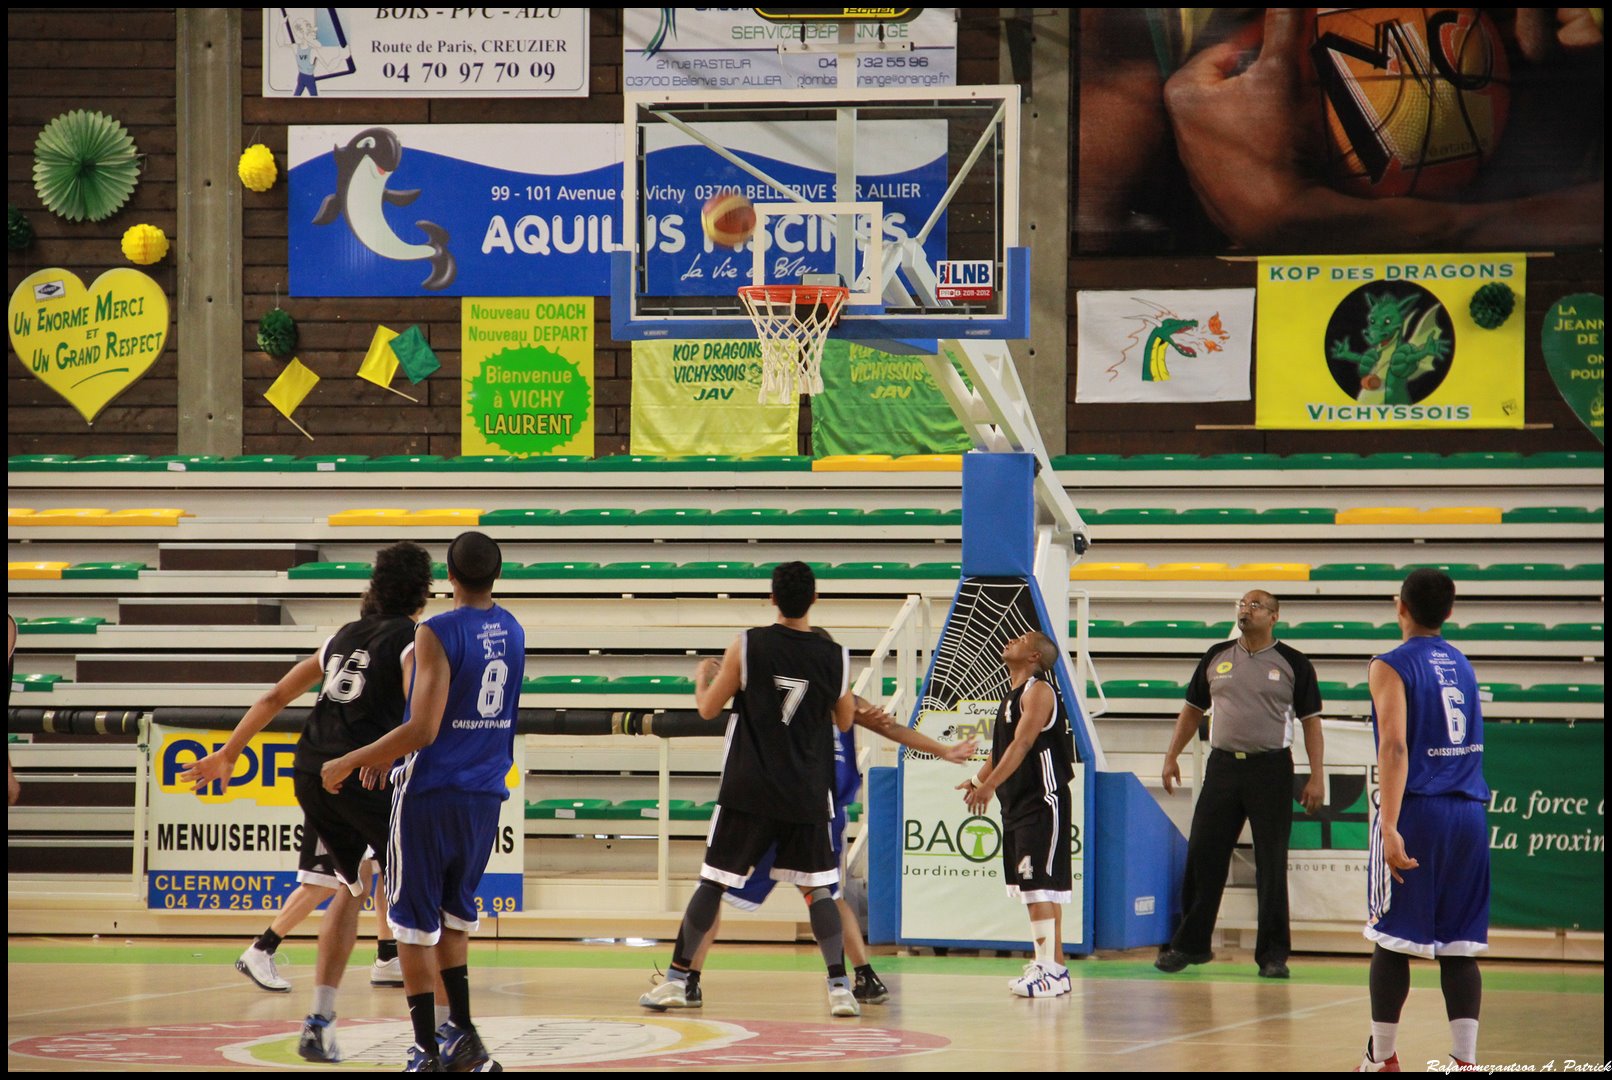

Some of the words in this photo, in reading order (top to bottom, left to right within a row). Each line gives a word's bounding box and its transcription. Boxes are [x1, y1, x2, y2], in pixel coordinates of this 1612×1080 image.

[375, 8, 429, 19] BOIS
[450, 8, 495, 19] PVC
[515, 8, 562, 19] ALU
[731, 24, 801, 40] SERVICE
[371, 40, 412, 53] Route
[416, 40, 432, 53] de
[437, 40, 477, 55] Paris,
[481, 39, 567, 53] CREUZIER
[656, 59, 669, 70] 21
[671, 60, 691, 70] rue
[693, 59, 751, 70] PASTEUR
[818, 57, 837, 69] 04
[864, 57, 883, 68] 32
[886, 57, 905, 68] 55
[909, 57, 929, 68] 96
[382, 62, 410, 83] 04
[421, 62, 447, 83] 70
[459, 62, 484, 83] 97
[494, 62, 520, 83] 70
[529, 62, 555, 83] 09
[625, 76, 670, 87] 03700
[719, 77, 740, 87] sur
[742, 75, 782, 86] ALLIER
[491, 185, 510, 200] 99
[526, 185, 551, 200] 101
[556, 185, 616, 201] Avenue
[646, 185, 686, 204] Vichy
[832, 183, 863, 199] SR
[868, 183, 921, 199] ALLIER
[703, 212, 908, 254] SCINES
[681, 253, 704, 281] La
[951, 263, 990, 284] LNB
[1269, 266, 1321, 282] KOP
[1331, 267, 1375, 281] DES
[1385, 263, 1515, 281] DRAGONS
[471, 304, 530, 320] Nouveau
[535, 303, 586, 320] COACH
[1557, 304, 1577, 316] LA
[86, 328, 100, 340] ET
[468, 326, 528, 342] Nouveau
[533, 325, 588, 342] DEPART
[1577, 333, 1600, 345] DE
[672, 342, 700, 361] KOP
[703, 341, 763, 361] DRAGONS
[485, 365, 573, 384] Bienvenue
[673, 363, 747, 384] VICHYSSOIS
[850, 361, 924, 384] VICHYSSOIS
[493, 390, 503, 409] à
[510, 390, 565, 409] VICHY
[693, 387, 735, 401] JAV
[870, 385, 912, 399] JAV
[1306, 403, 1472, 421] VICHYSSOIS
[484, 413, 574, 435] LAURENT
[318, 648, 371, 704] 16
[476, 659, 509, 718] 8
[772, 674, 810, 726] 7
[1441, 686, 1467, 745] 6
[1488, 789, 1517, 813] La
[1522, 789, 1589, 820] force
[157, 823, 304, 852] MENUISERIES
[904, 815, 1082, 863] BAOB
[1489, 826, 1518, 850] La
[902, 865, 998, 878] Jardinerie
[1017, 855, 1034, 880] 4
[1287, 863, 1336, 872] GROUPE
[155, 875, 275, 891] CLERMONT
[164, 893, 188, 909] 04
[197, 893, 220, 909] 73
[230, 894, 253, 910] 25
[261, 895, 283, 910] 61
[492, 896, 516, 912] 99
